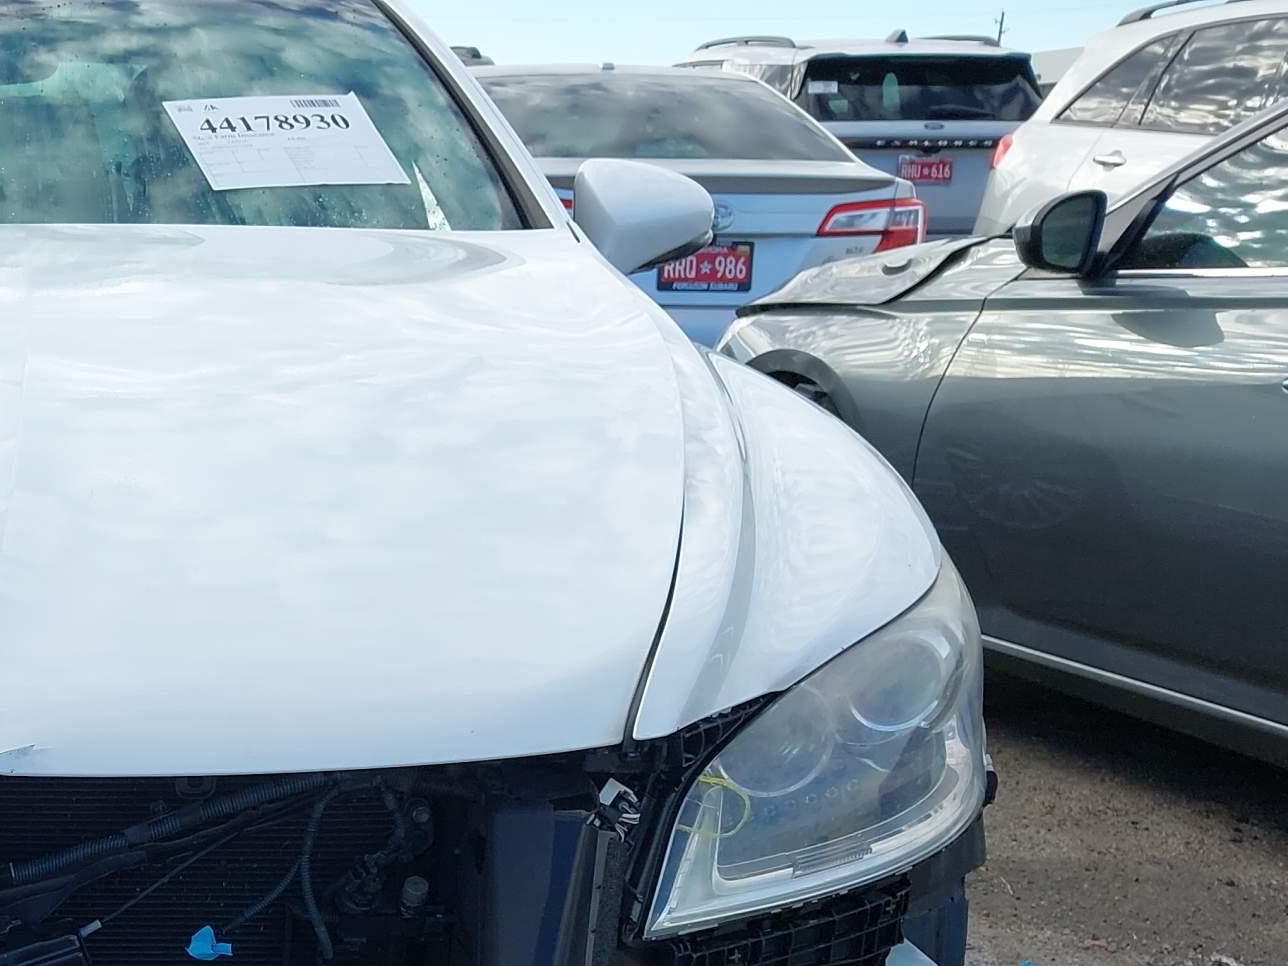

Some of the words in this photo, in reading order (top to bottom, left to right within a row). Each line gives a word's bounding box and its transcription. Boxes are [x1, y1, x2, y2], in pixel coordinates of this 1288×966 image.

[199, 113, 350, 134] 44178930
[930, 163, 951, 179] 616
[714, 255, 747, 279] 986
